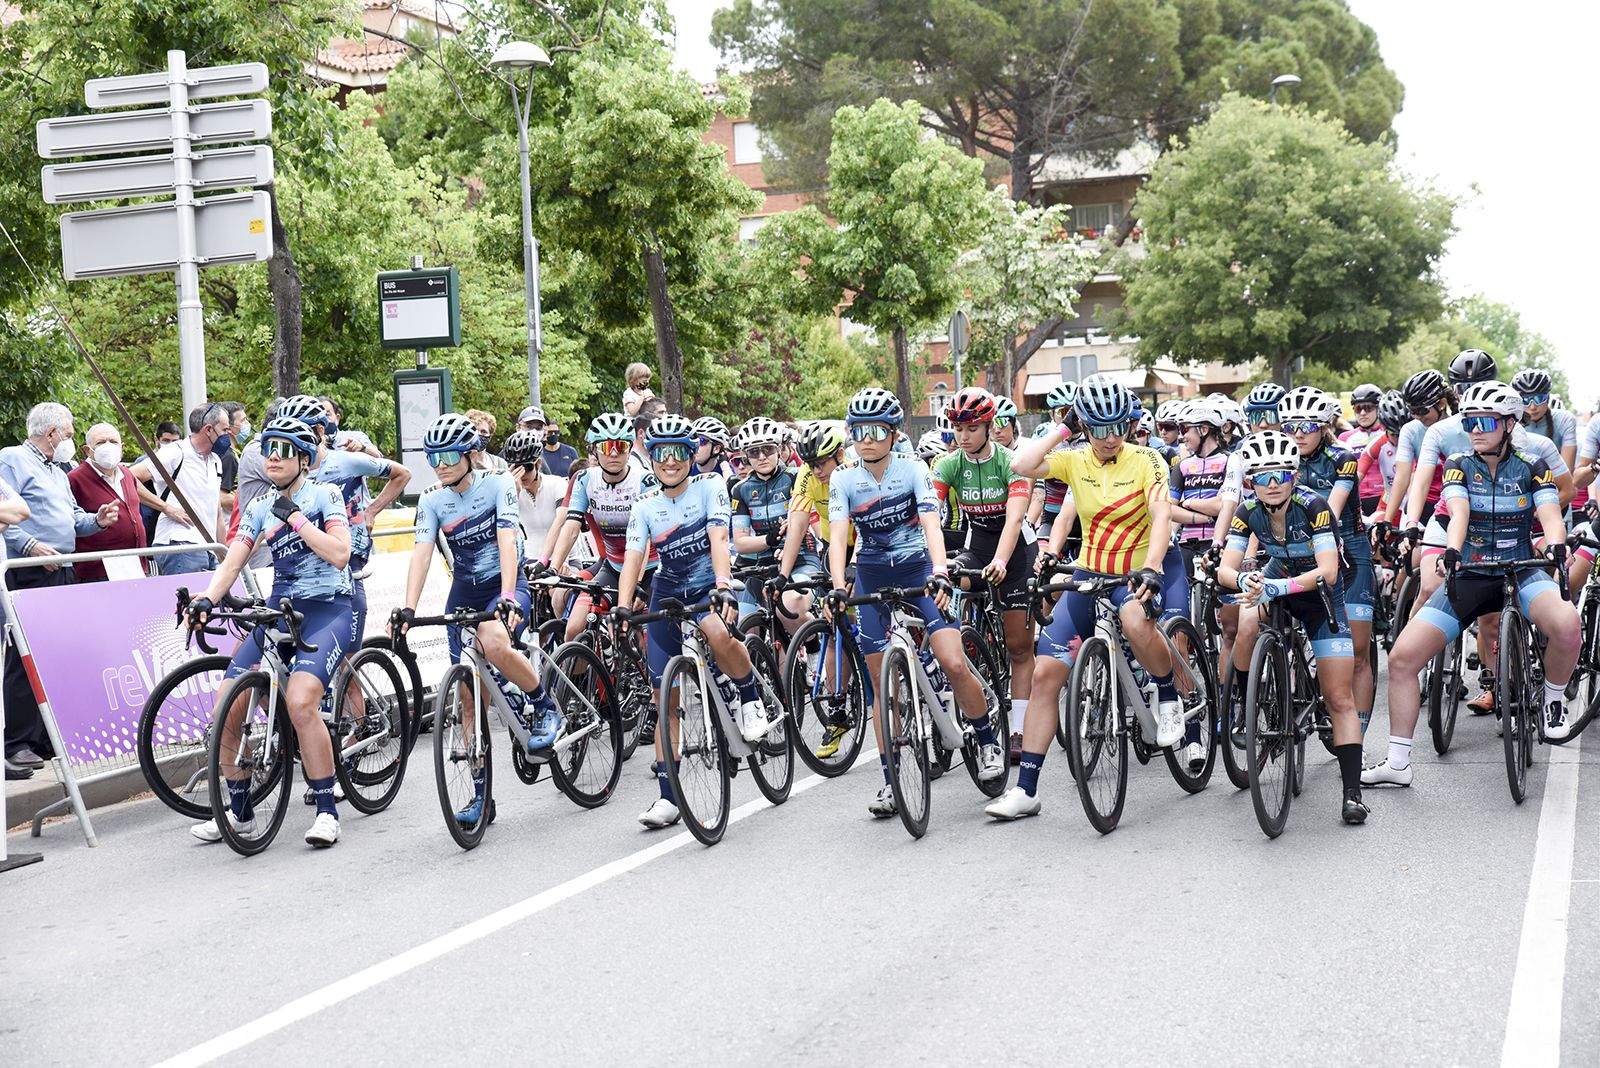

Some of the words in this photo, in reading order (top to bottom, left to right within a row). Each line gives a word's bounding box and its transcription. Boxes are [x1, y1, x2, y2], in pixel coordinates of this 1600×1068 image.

[384, 282, 396, 290] BUS
[866, 511, 910, 528] TACTIC
[667, 538, 710, 559] TACTIC
